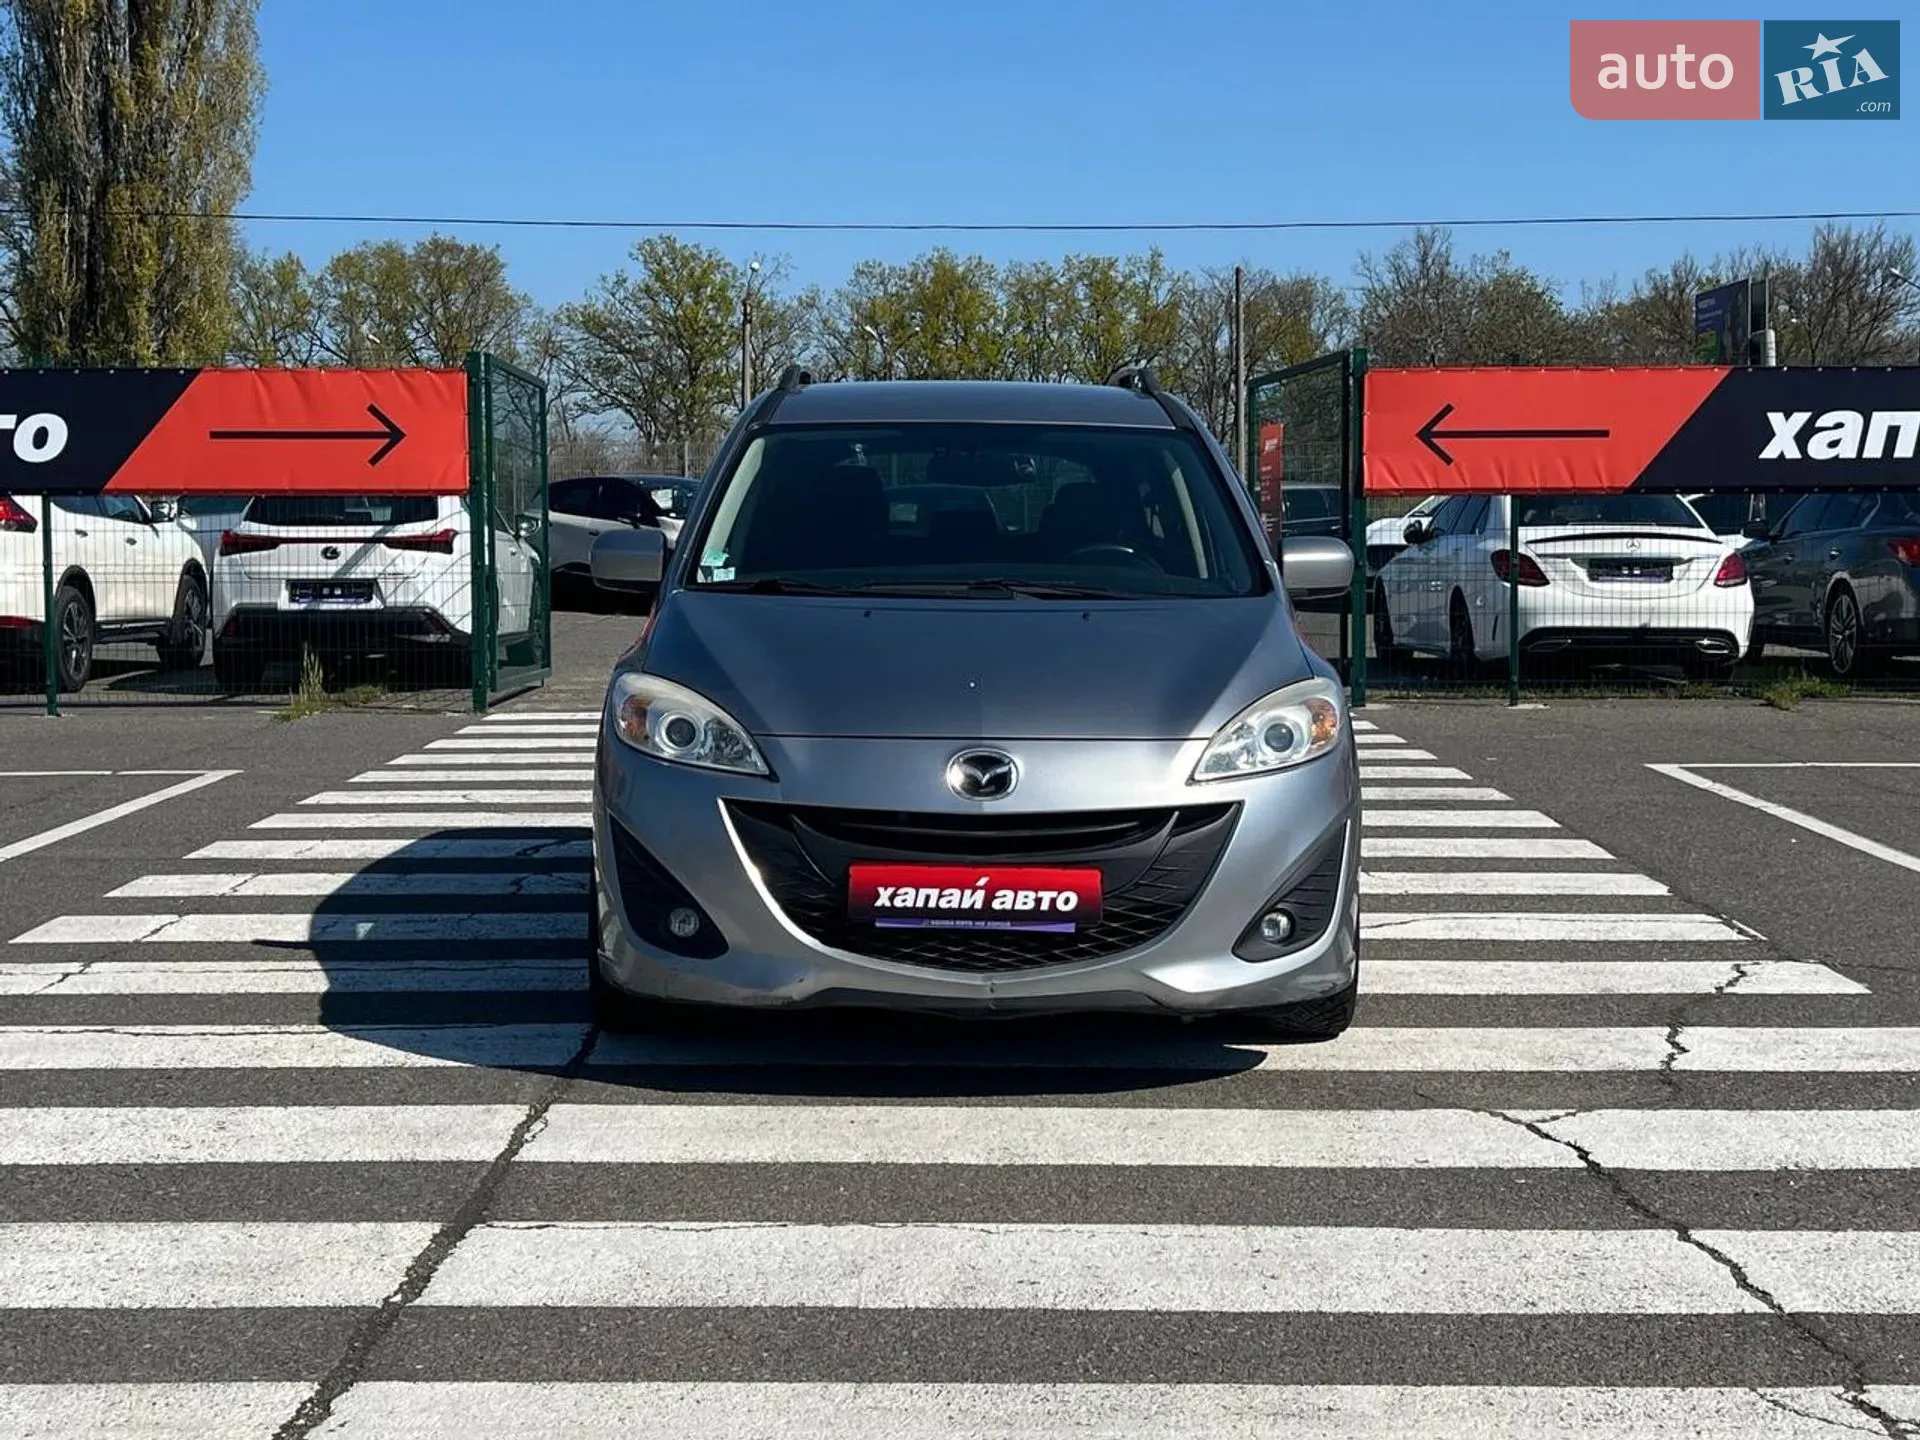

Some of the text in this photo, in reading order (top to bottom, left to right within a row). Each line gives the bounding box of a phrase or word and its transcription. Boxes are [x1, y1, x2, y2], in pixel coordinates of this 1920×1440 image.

[1758, 410, 1920, 460] хап
[875, 876, 1079, 912] хапай авто
